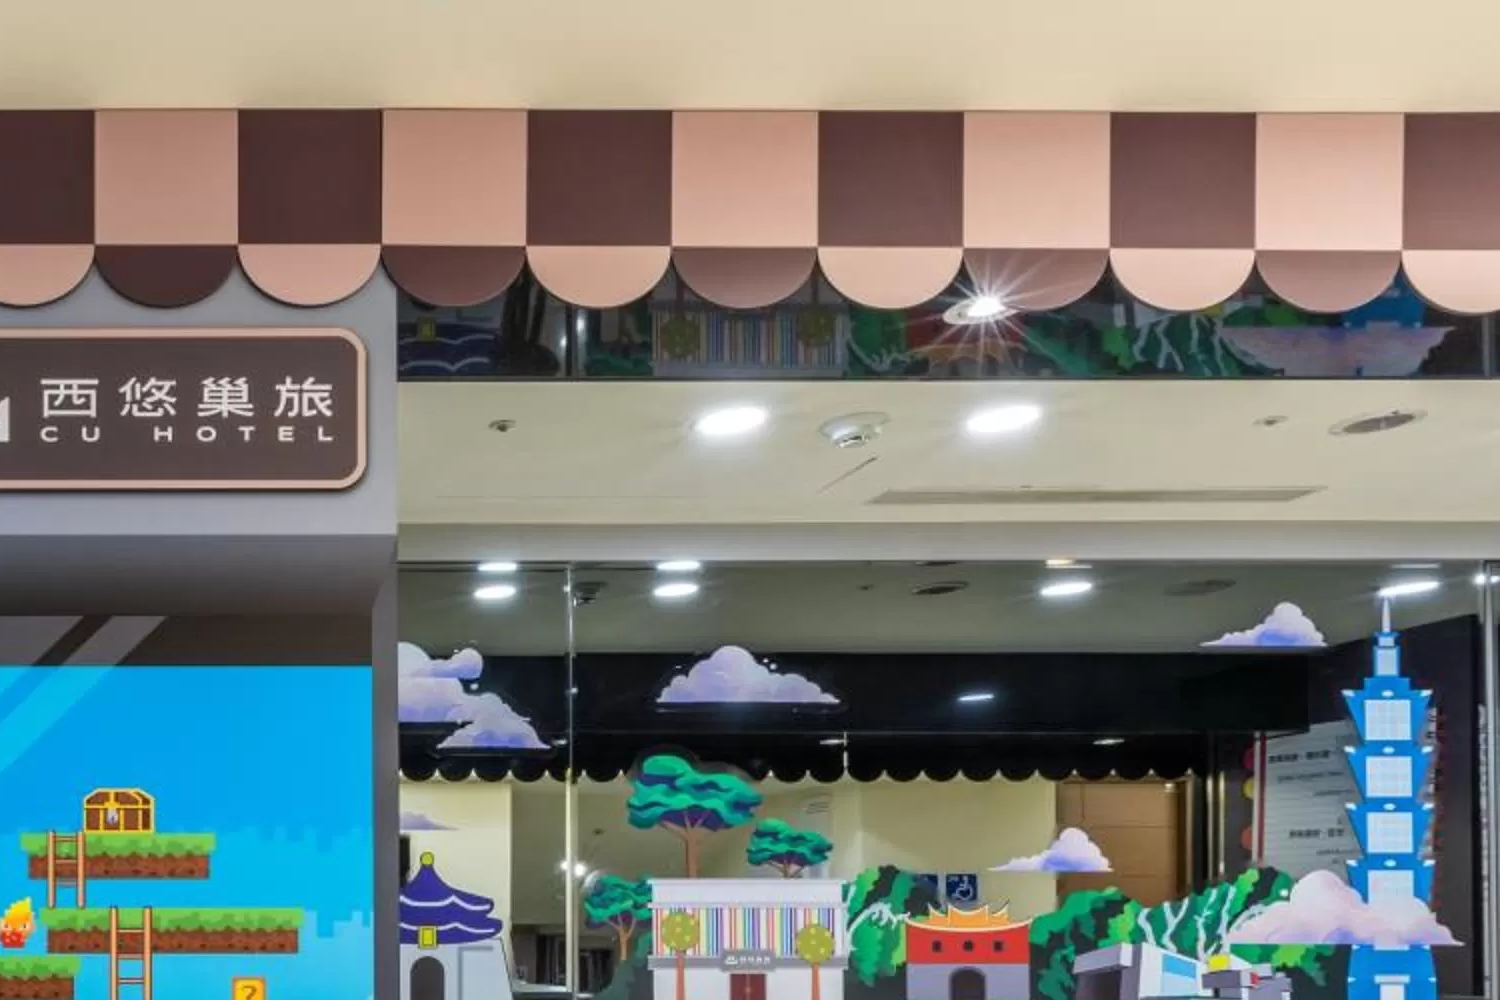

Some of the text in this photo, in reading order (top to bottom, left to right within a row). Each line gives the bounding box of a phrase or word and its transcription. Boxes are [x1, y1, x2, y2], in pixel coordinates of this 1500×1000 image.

[40, 375, 334, 419] 西悠巢旅
[40, 426, 334, 443] CU HOTEL
